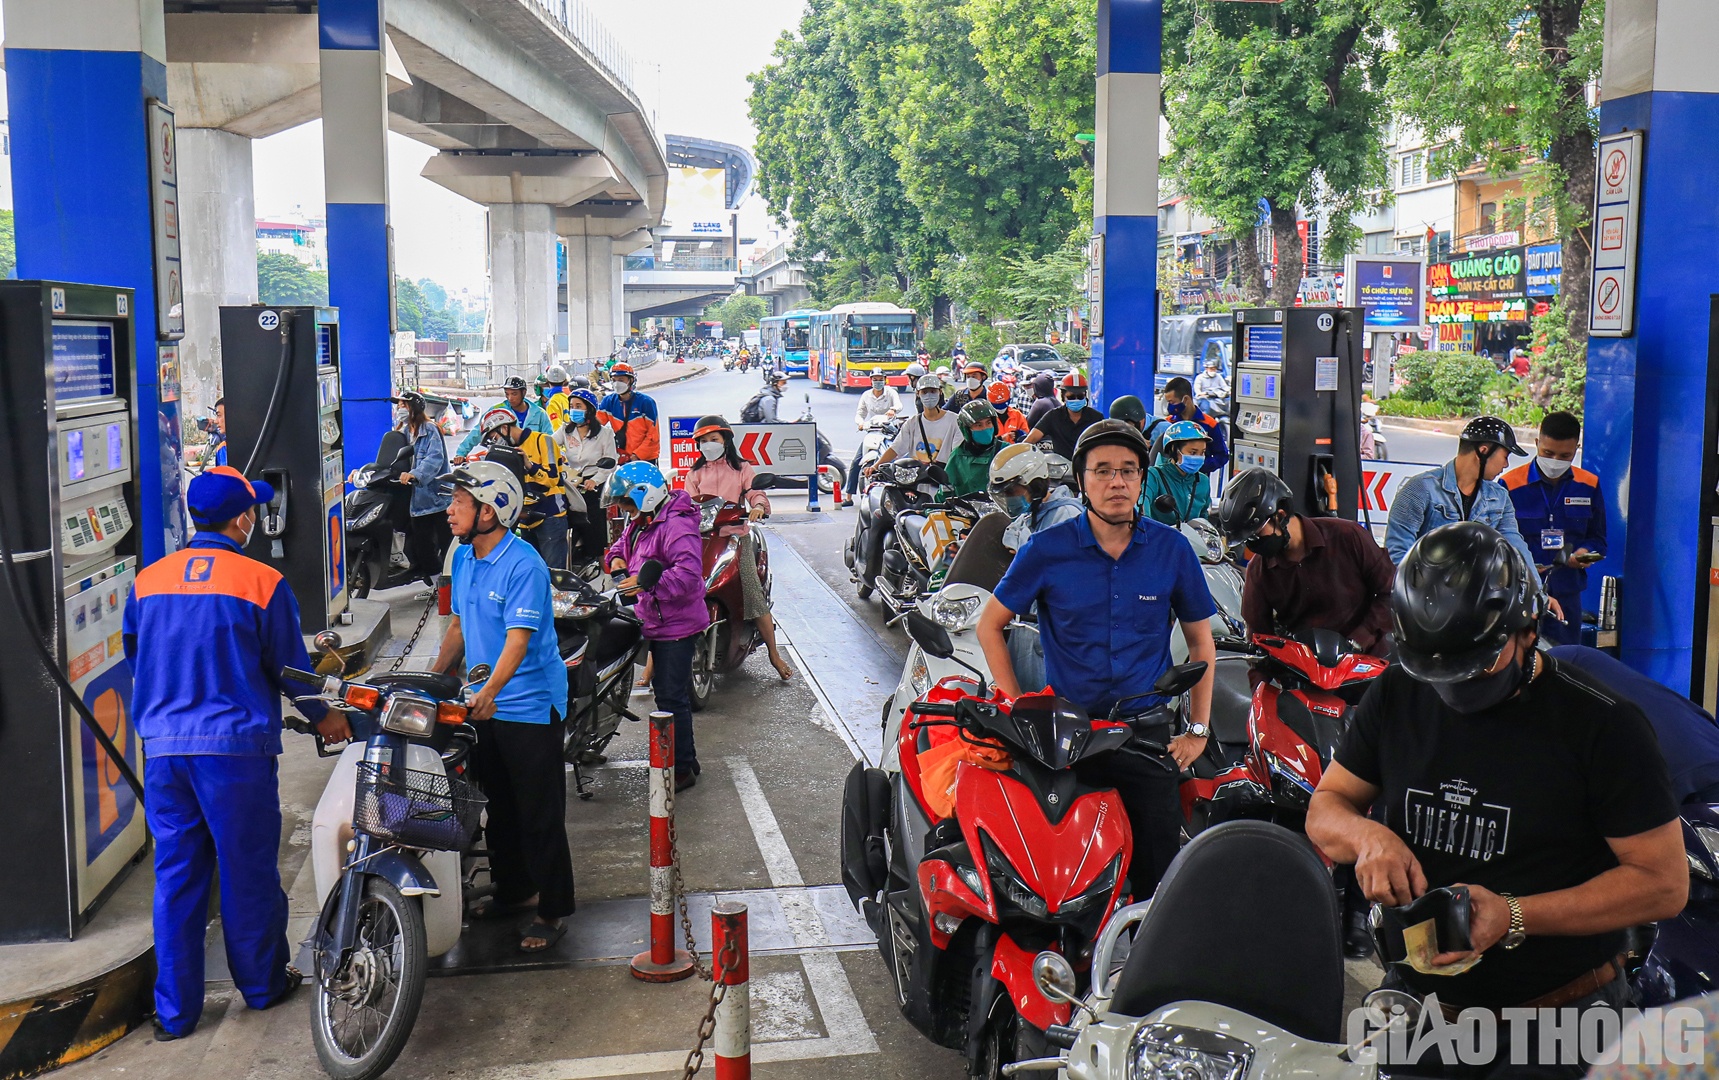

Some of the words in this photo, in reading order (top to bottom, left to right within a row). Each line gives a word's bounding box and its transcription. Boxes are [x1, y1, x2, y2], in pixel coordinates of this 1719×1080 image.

[1470, 234, 1514, 248] PHOTOCOPY
[1450, 251, 1493, 279] QUẢNG
[1494, 250, 1521, 275] CÁO
[1361, 284, 1370, 294] TỔ
[1371, 286, 1388, 295] CHỨC
[1389, 287, 1398, 296] SỰ
[1398, 286, 1414, 296] KIỆN
[54, 292, 63, 309] 24
[119, 297, 126, 313] 23
[1429, 300, 1456, 315] DÁN
[1457, 301, 1474, 315] XE
[262, 316, 277, 325] 22
[1320, 318, 1332, 326] 19
[1429, 314, 1450, 324] BỌC
[1451, 313, 1472, 323] YÊN
[673, 440, 693, 453] ĐIỂM
